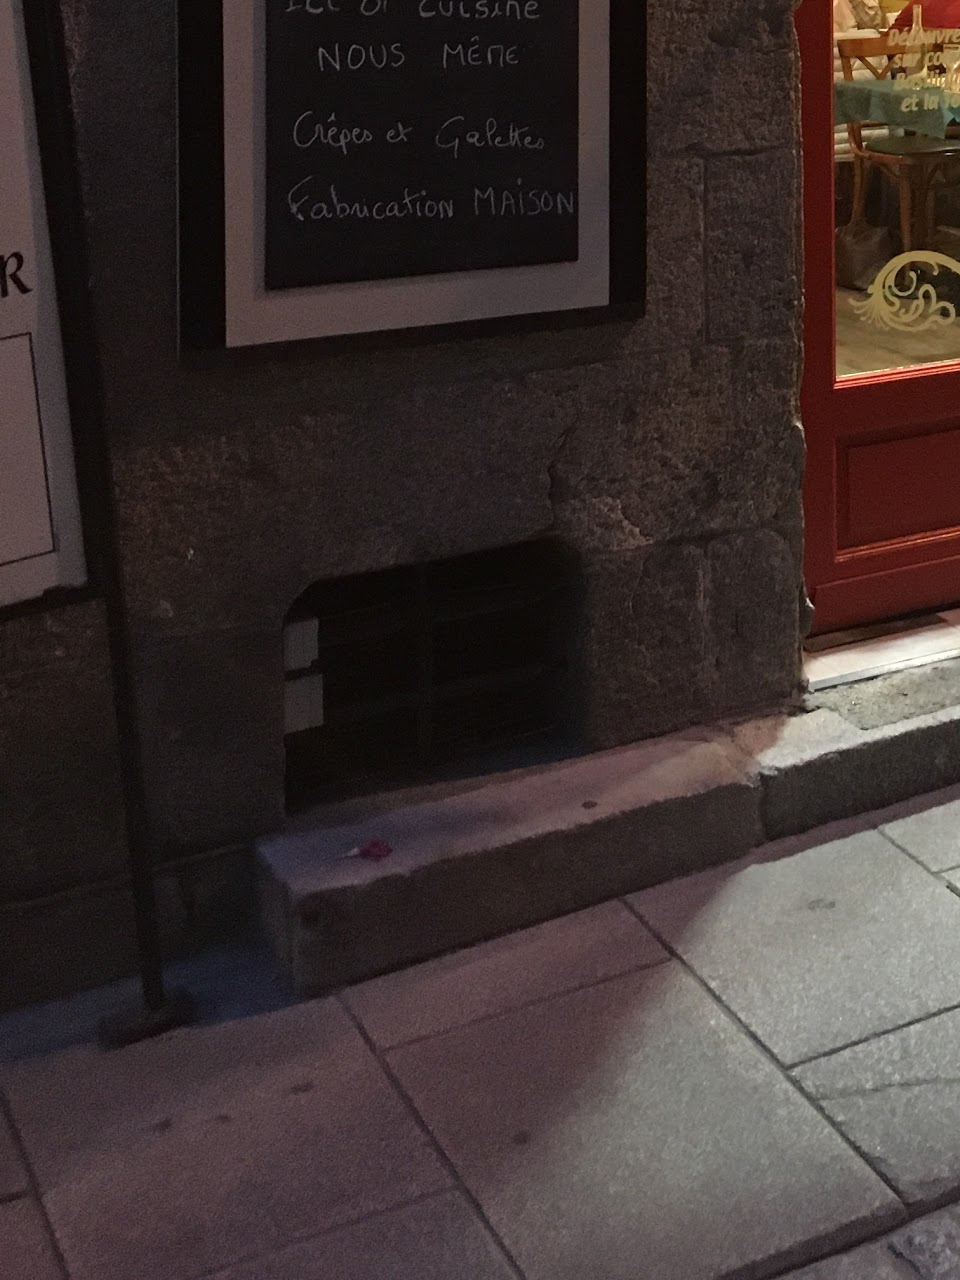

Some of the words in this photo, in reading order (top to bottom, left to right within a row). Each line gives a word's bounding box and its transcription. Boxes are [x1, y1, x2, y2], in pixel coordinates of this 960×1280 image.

[317, 41, 406, 72] NOUS
[901, 95, 919, 112] et
[923, 92, 940, 110] la
